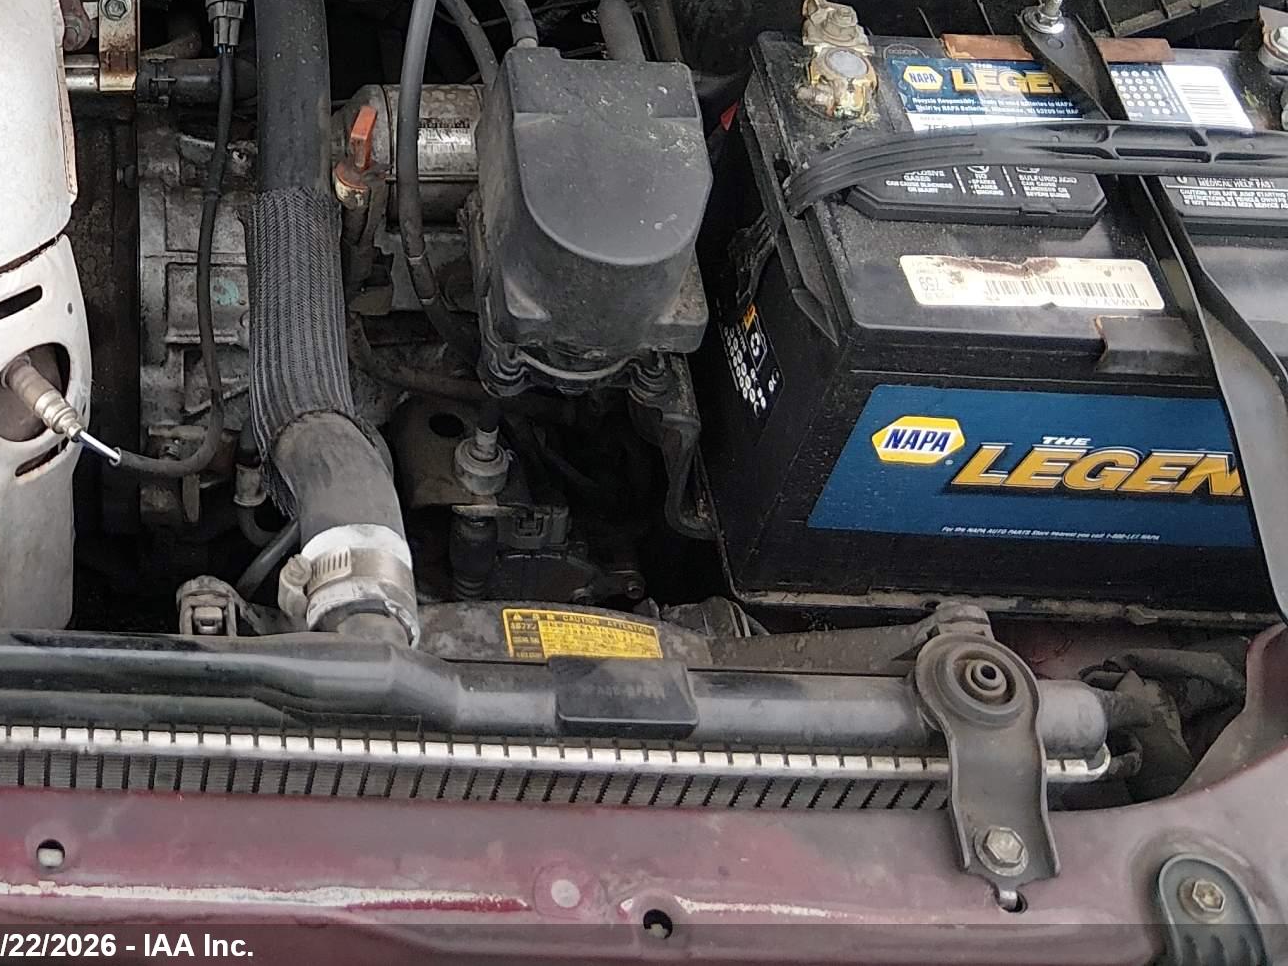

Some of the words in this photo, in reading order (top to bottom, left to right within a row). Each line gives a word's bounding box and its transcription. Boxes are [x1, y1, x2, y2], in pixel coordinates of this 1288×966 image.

[908, 72, 938, 85] NAPA
[950, 67, 1063, 94] LEGE
[1019, 174, 1057, 183] SULFURIC
[1199, 179, 1233, 187] MEDICAL
[1233, 179, 1254, 188] HELP
[883, 428, 952, 452] NAPA
[1041, 435, 1092, 447] THE
[1007, 528, 1030, 536] PARTS
[562, 615, 600, 625] CAUTION
[607, 620, 651, 634] ATTENTION
